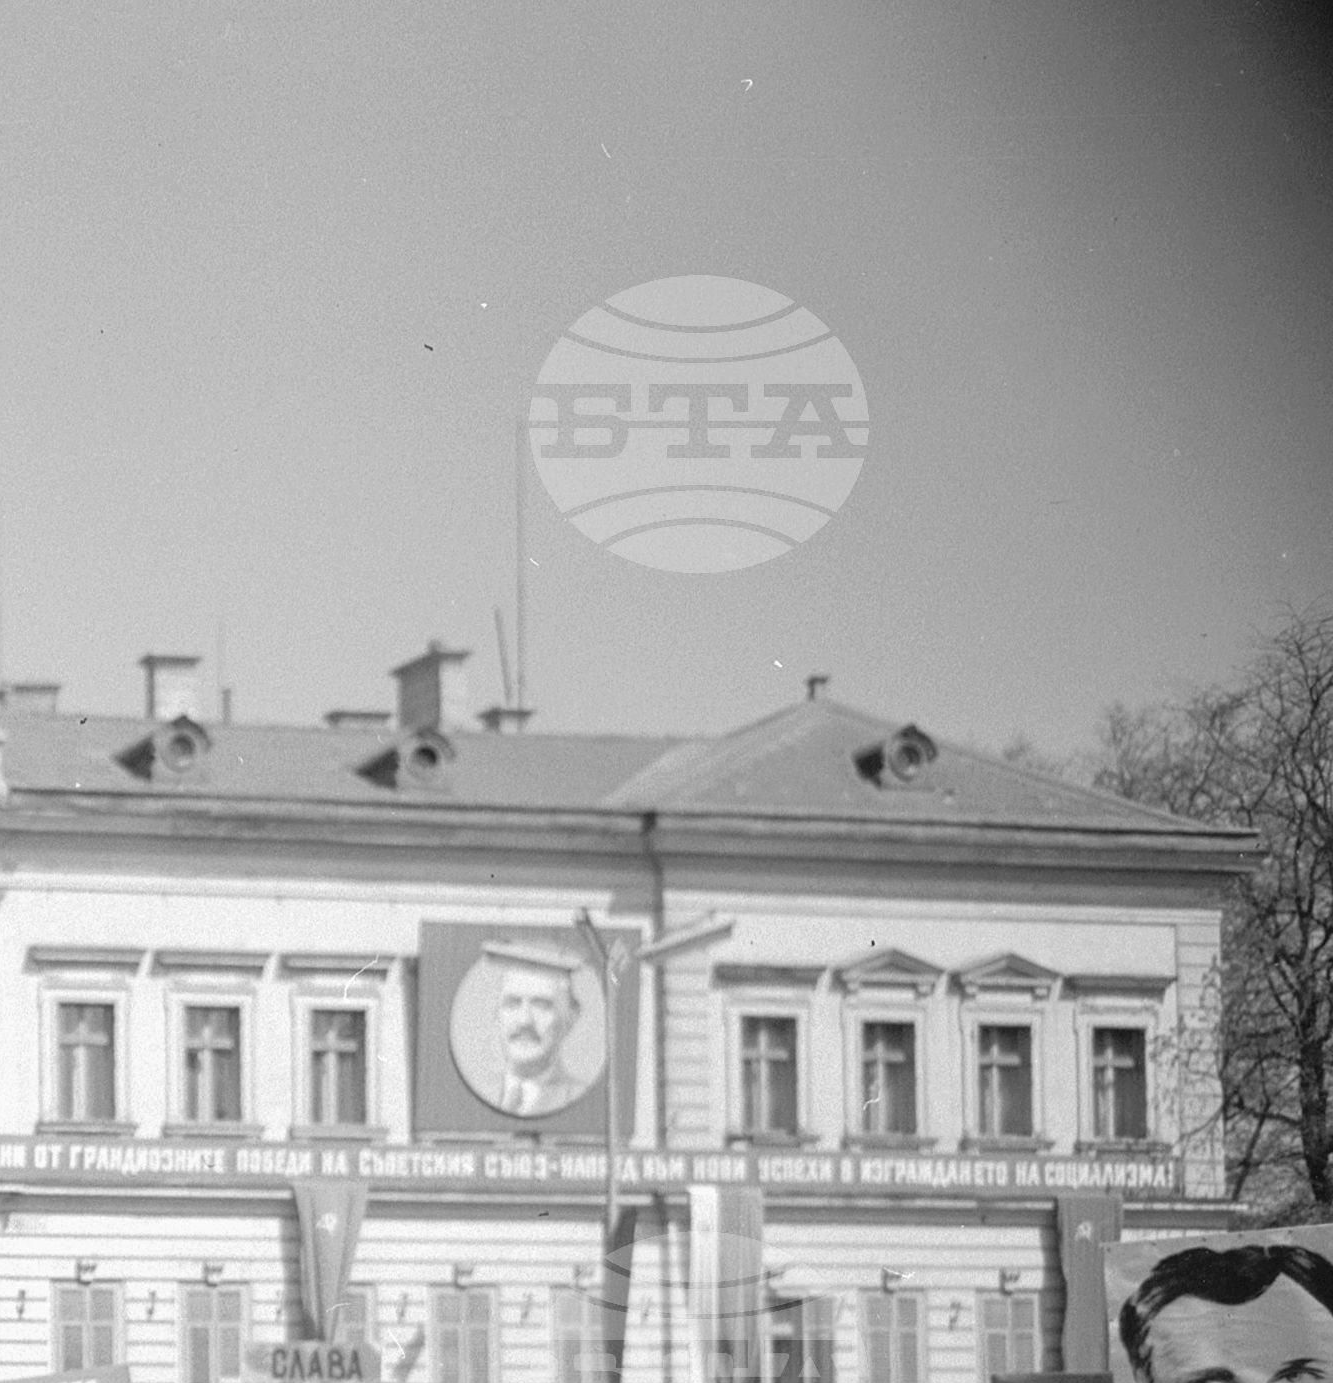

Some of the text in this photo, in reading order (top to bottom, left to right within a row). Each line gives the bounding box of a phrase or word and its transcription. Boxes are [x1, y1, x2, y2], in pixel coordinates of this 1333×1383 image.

[34, 1145, 62, 1170] ОТ
[236, 1148, 312, 1176] ПОБЕДИ
[321, 1150, 348, 1176] НА
[758, 1158, 833, 1182] УСПЕХИ
[860, 1160, 1007, 1187] ИЗГРАЖДАНЕТО
[1015, 1161, 1040, 1186] НА
[272, 1349, 363, 1381] СЛАВА
